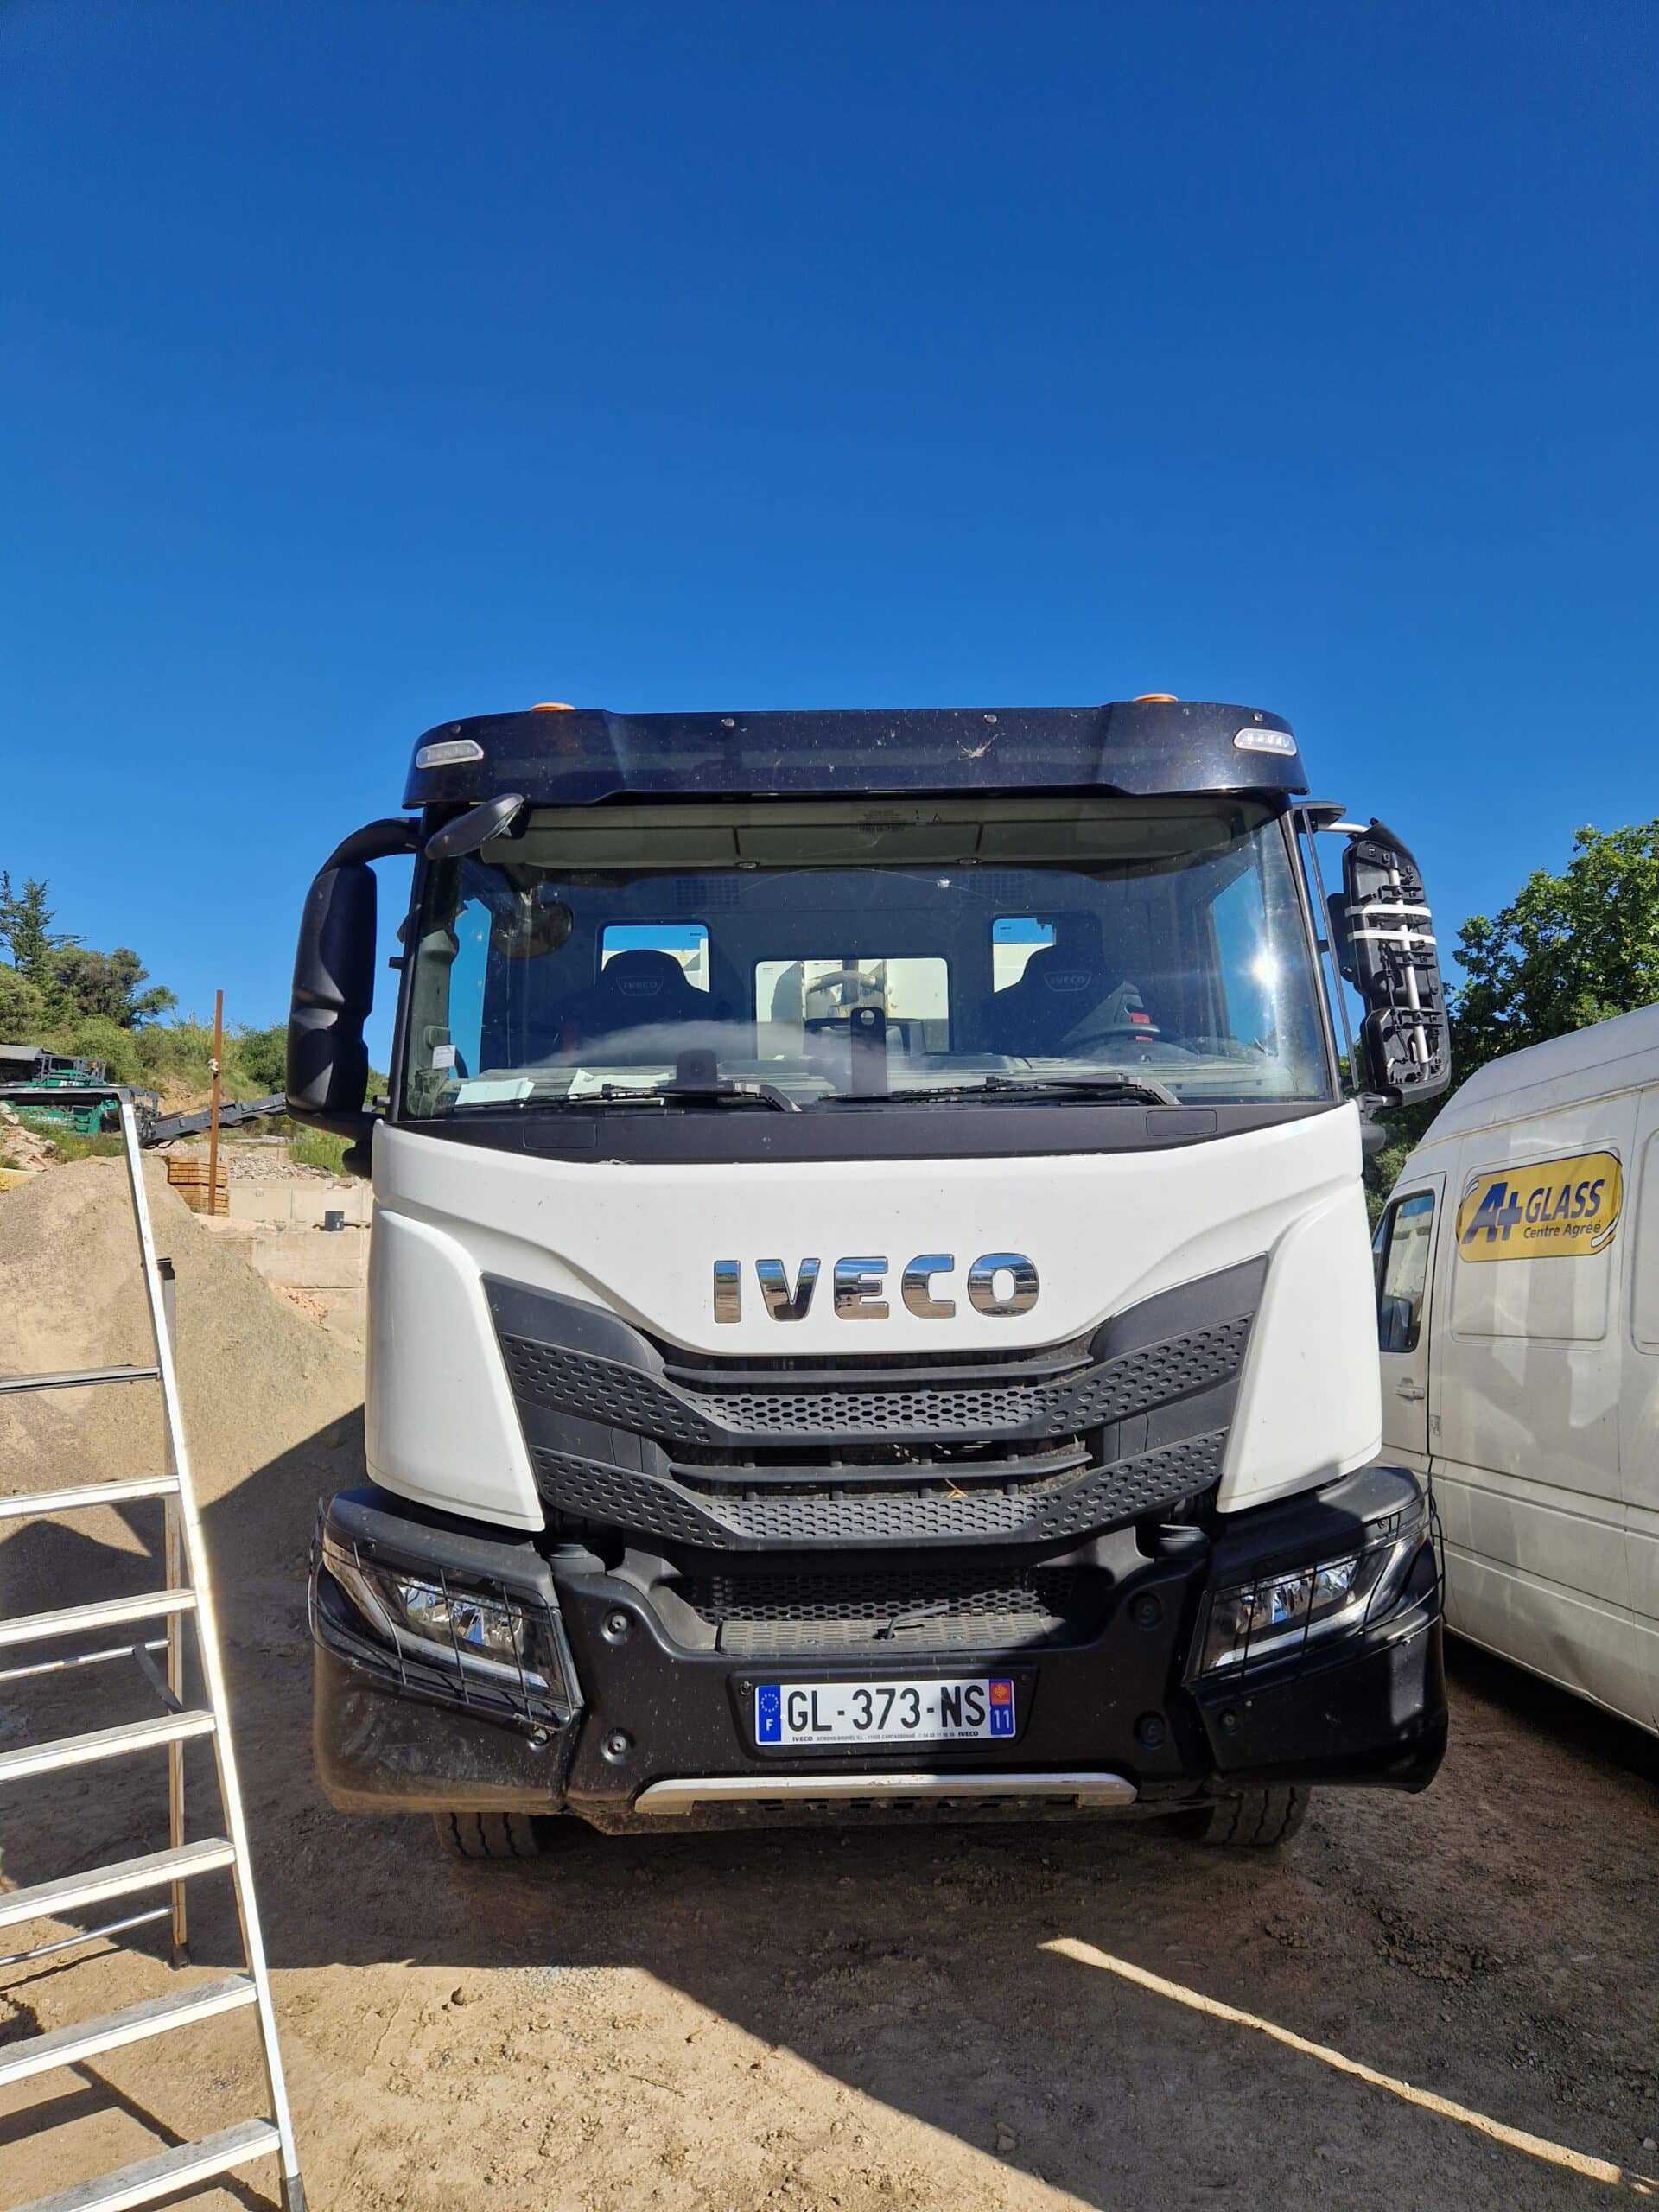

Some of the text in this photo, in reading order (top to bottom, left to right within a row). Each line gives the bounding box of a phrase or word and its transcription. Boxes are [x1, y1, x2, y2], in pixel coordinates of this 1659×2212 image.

[1462, 1179, 1605, 1245] A+ GLASS
[1523, 1219, 1602, 1240] Centre Agréé
[714, 1252, 1039, 1324] IVECO
[766, 1719, 774, 1732] F
[787, 1684, 986, 1732] GL-373-NS
[993, 1708, 1010, 1731] 11
